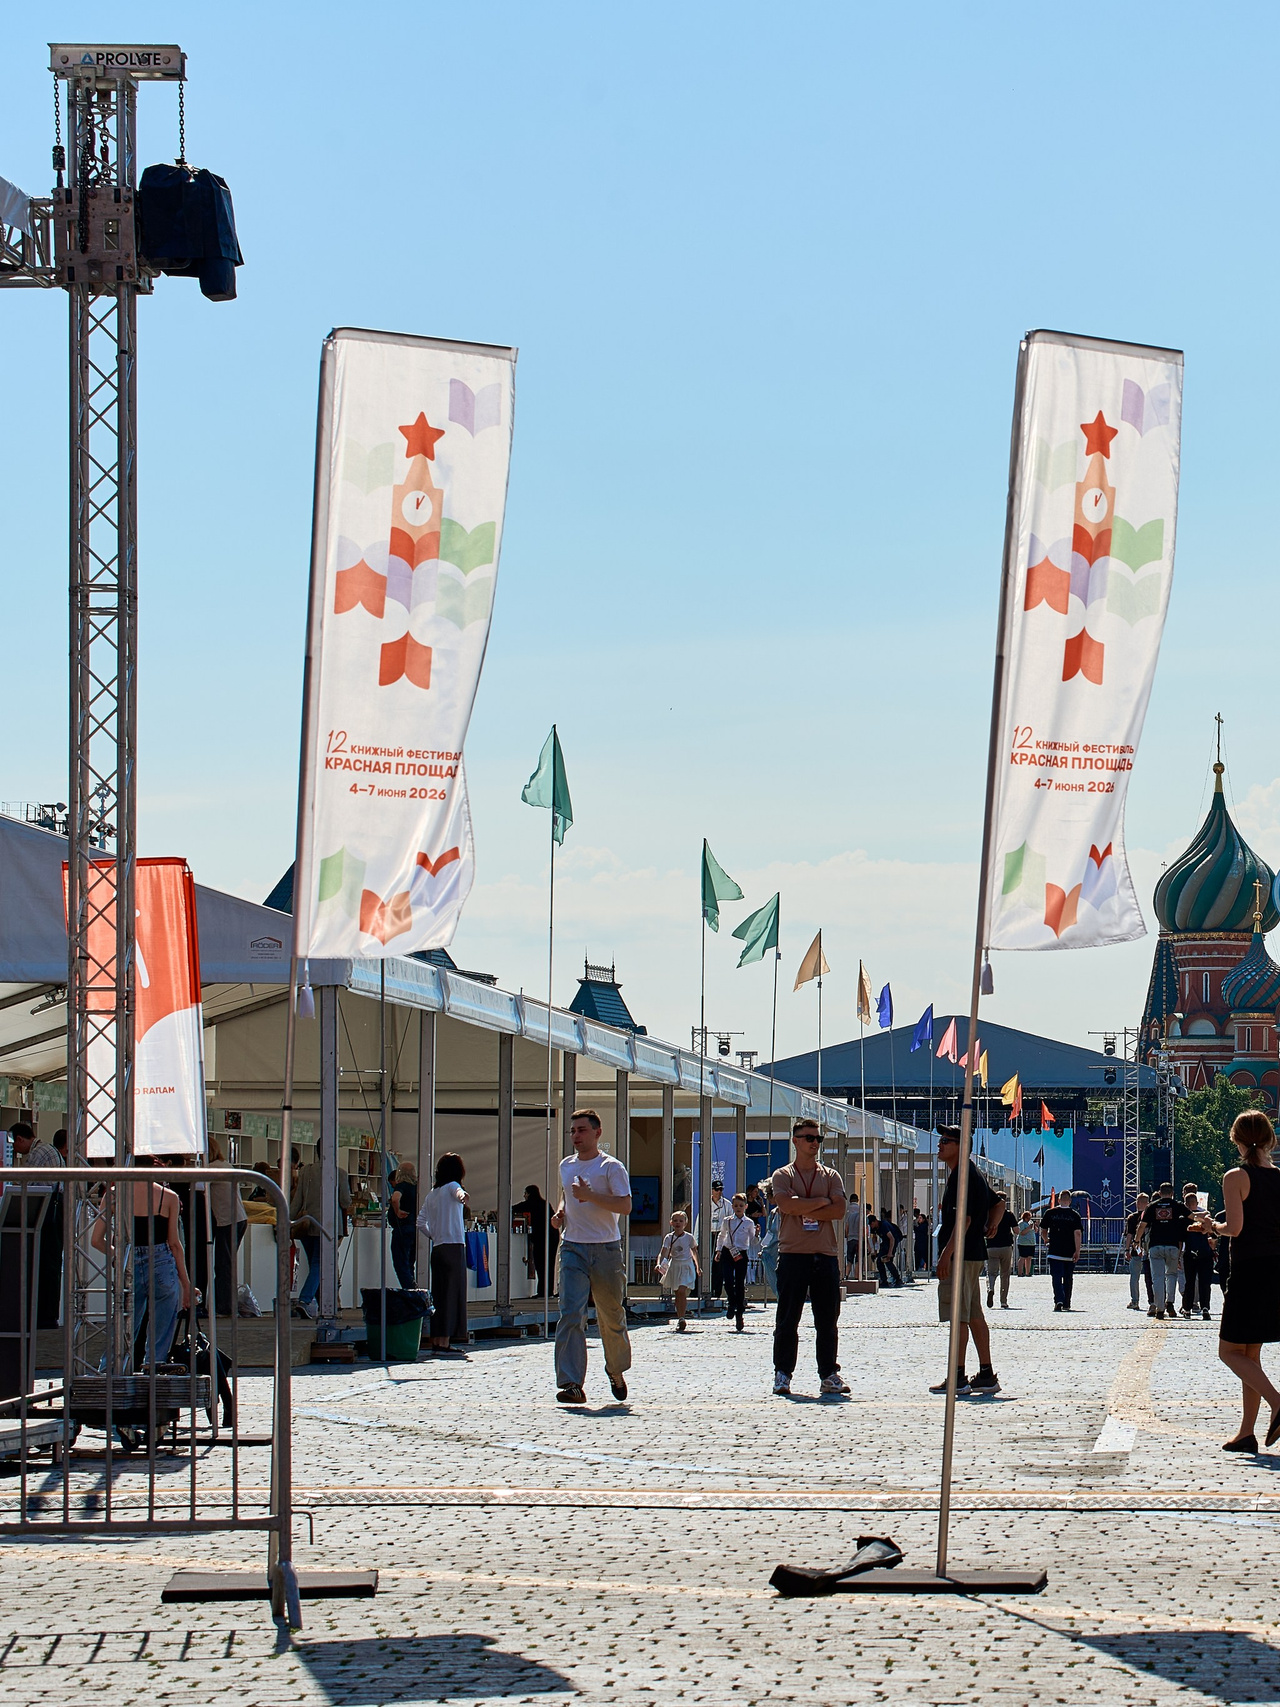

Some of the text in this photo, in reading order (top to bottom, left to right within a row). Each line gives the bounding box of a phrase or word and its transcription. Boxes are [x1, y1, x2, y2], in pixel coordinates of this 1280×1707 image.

[96, 52, 161, 66] PROLYTE
[326, 730, 347, 753] 12
[351, 745, 403, 757] КНИЖНЫЙ
[1012, 726, 1033, 749] 12
[1036, 740, 1079, 752] КНИЖНЫЙ
[325, 756, 392, 774] КРАСНАЯ
[1010, 753, 1068, 768] КРАСНАЯ
[409, 787, 446, 800] 2026
[1088, 781, 1115, 793] 2026
